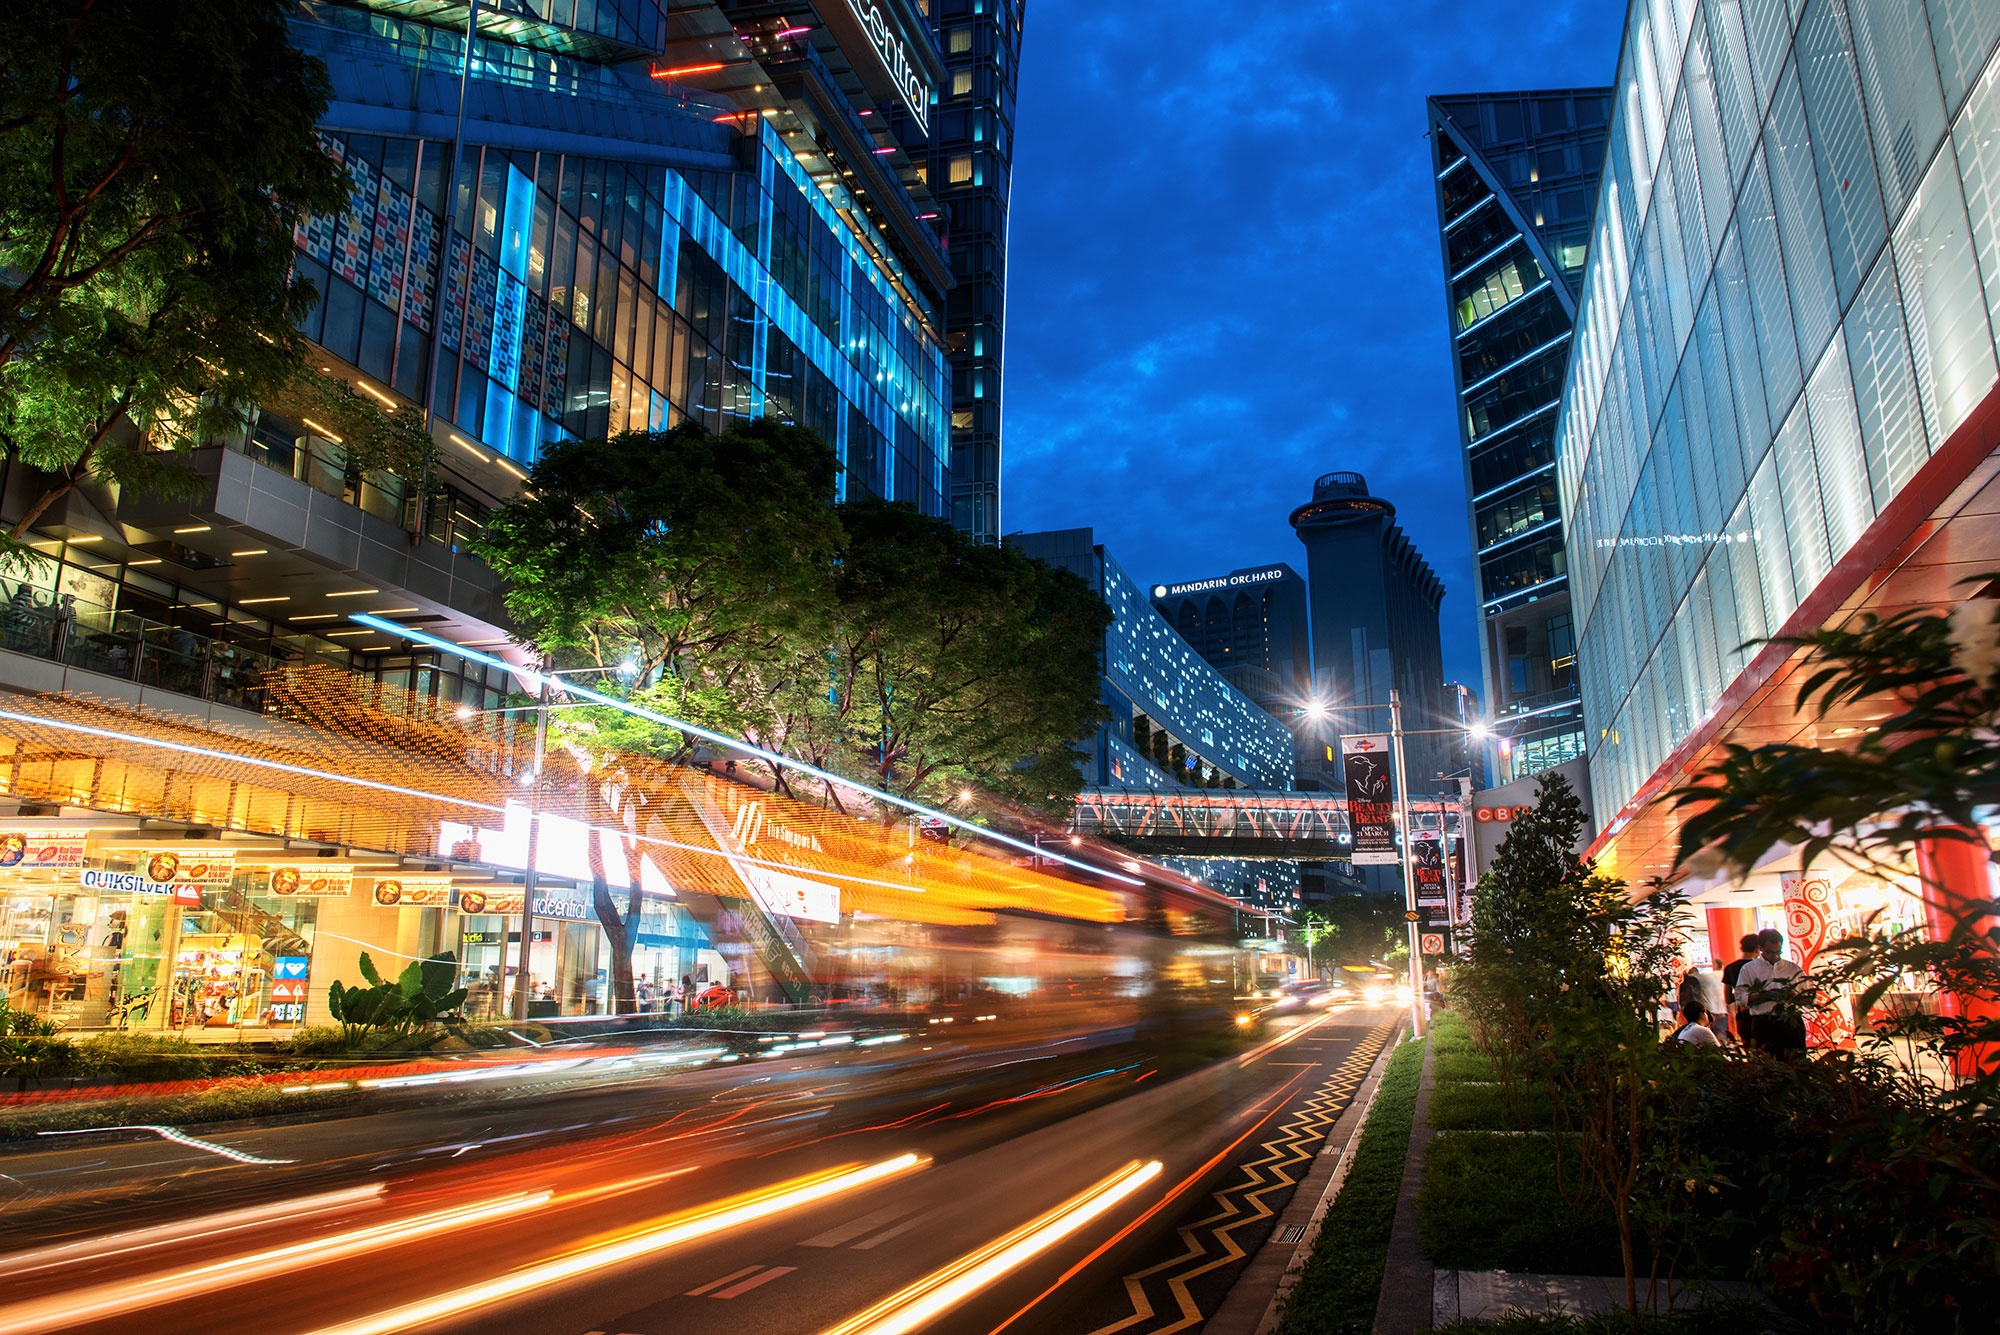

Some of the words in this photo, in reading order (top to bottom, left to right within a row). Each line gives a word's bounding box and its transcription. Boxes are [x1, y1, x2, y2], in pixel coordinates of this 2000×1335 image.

[1171, 578, 1227, 595] MANDARIN
[1230, 569, 1282, 586] ORCHARD
[1349, 800, 1392, 813] BEAUTY
[1356, 812, 1389, 824] BEAST
[85, 870, 175, 895] QUIKSILVER
[749, 908, 772, 944] TOKYU
[781, 960, 802, 992] #B1-07
